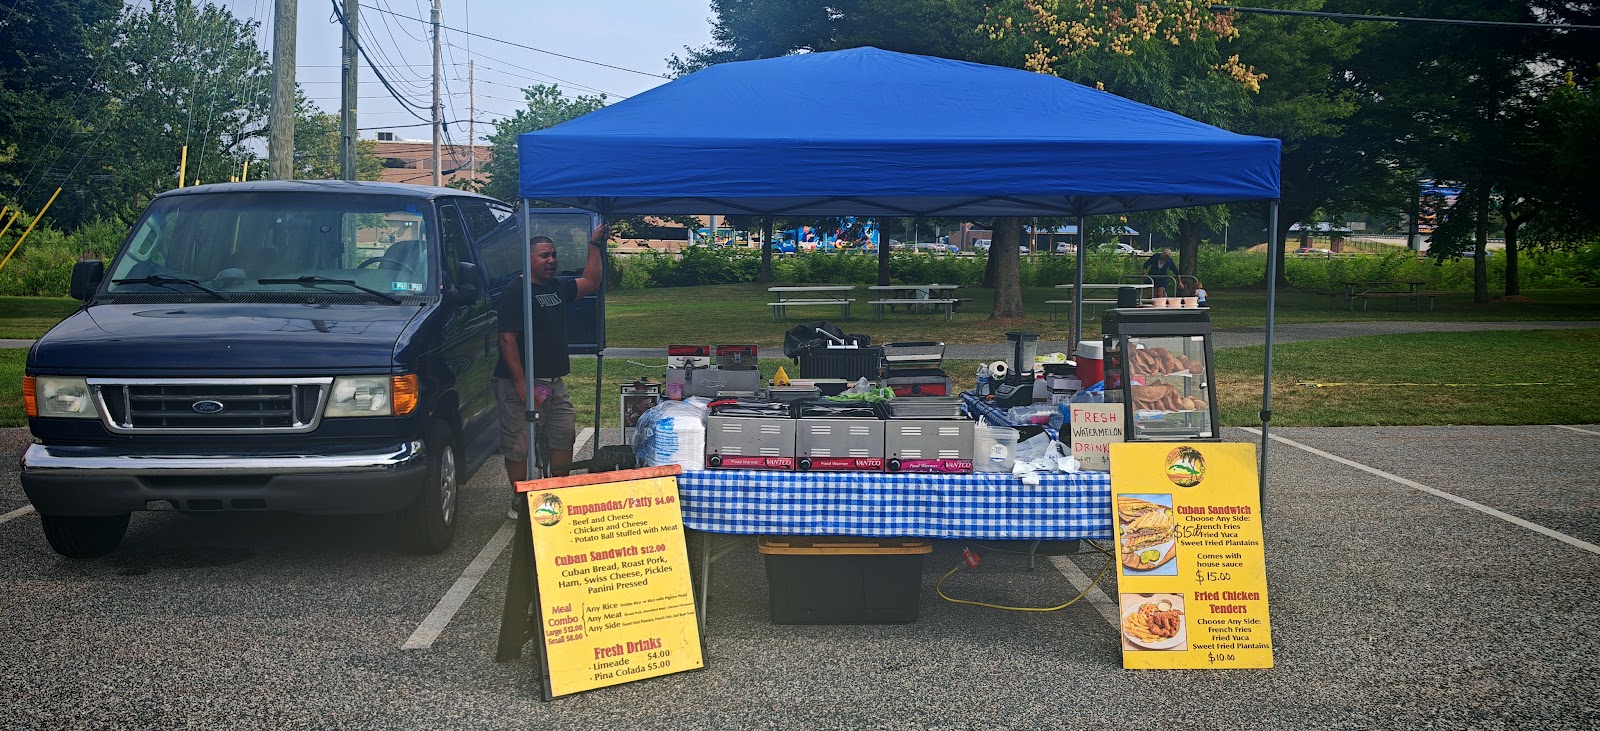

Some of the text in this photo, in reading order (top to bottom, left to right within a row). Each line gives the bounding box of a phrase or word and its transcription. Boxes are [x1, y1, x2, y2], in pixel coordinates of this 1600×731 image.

[1074, 409, 1116, 423] FRESH
[1073, 426, 1122, 437] WATERMELON
[567, 496, 652, 516] Empanadas/Patty
[654, 496, 675, 506] $4.00
[1177, 506, 1251, 514] Cuban Sandwich
[572, 513, 634, 526] Beef and Cheese
[574, 520, 648, 534] Chicken and Cheese
[575, 524, 678, 543] Potato Ball Stuffed with Meat
[555, 544, 666, 566] Cuban Sandwich $12.00
[562, 556, 668, 577] Cuban Bread, Roast Pork,
[558, 566, 672, 588] Ham, Swiss Cheese, Pickles
[588, 578, 648, 594] Panini Pressed
[1194, 591, 1260, 600] Fried Chicken
[552, 602, 572, 614] Meal
[602, 602, 618, 610] Rice
[1209, 604, 1247, 614] Tenders
[548, 614, 578, 626] Combo
[604, 612, 622, 620] Meat
[546, 624, 582, 636] Large $12.00
[604, 622, 620, 630] Side
[548, 633, 582, 645] Small $8.00
[594, 638, 662, 660] Fresh Drinks
[594, 650, 670, 670] Limeade $4.00
[594, 660, 670, 680] Pina Colada $5.00
